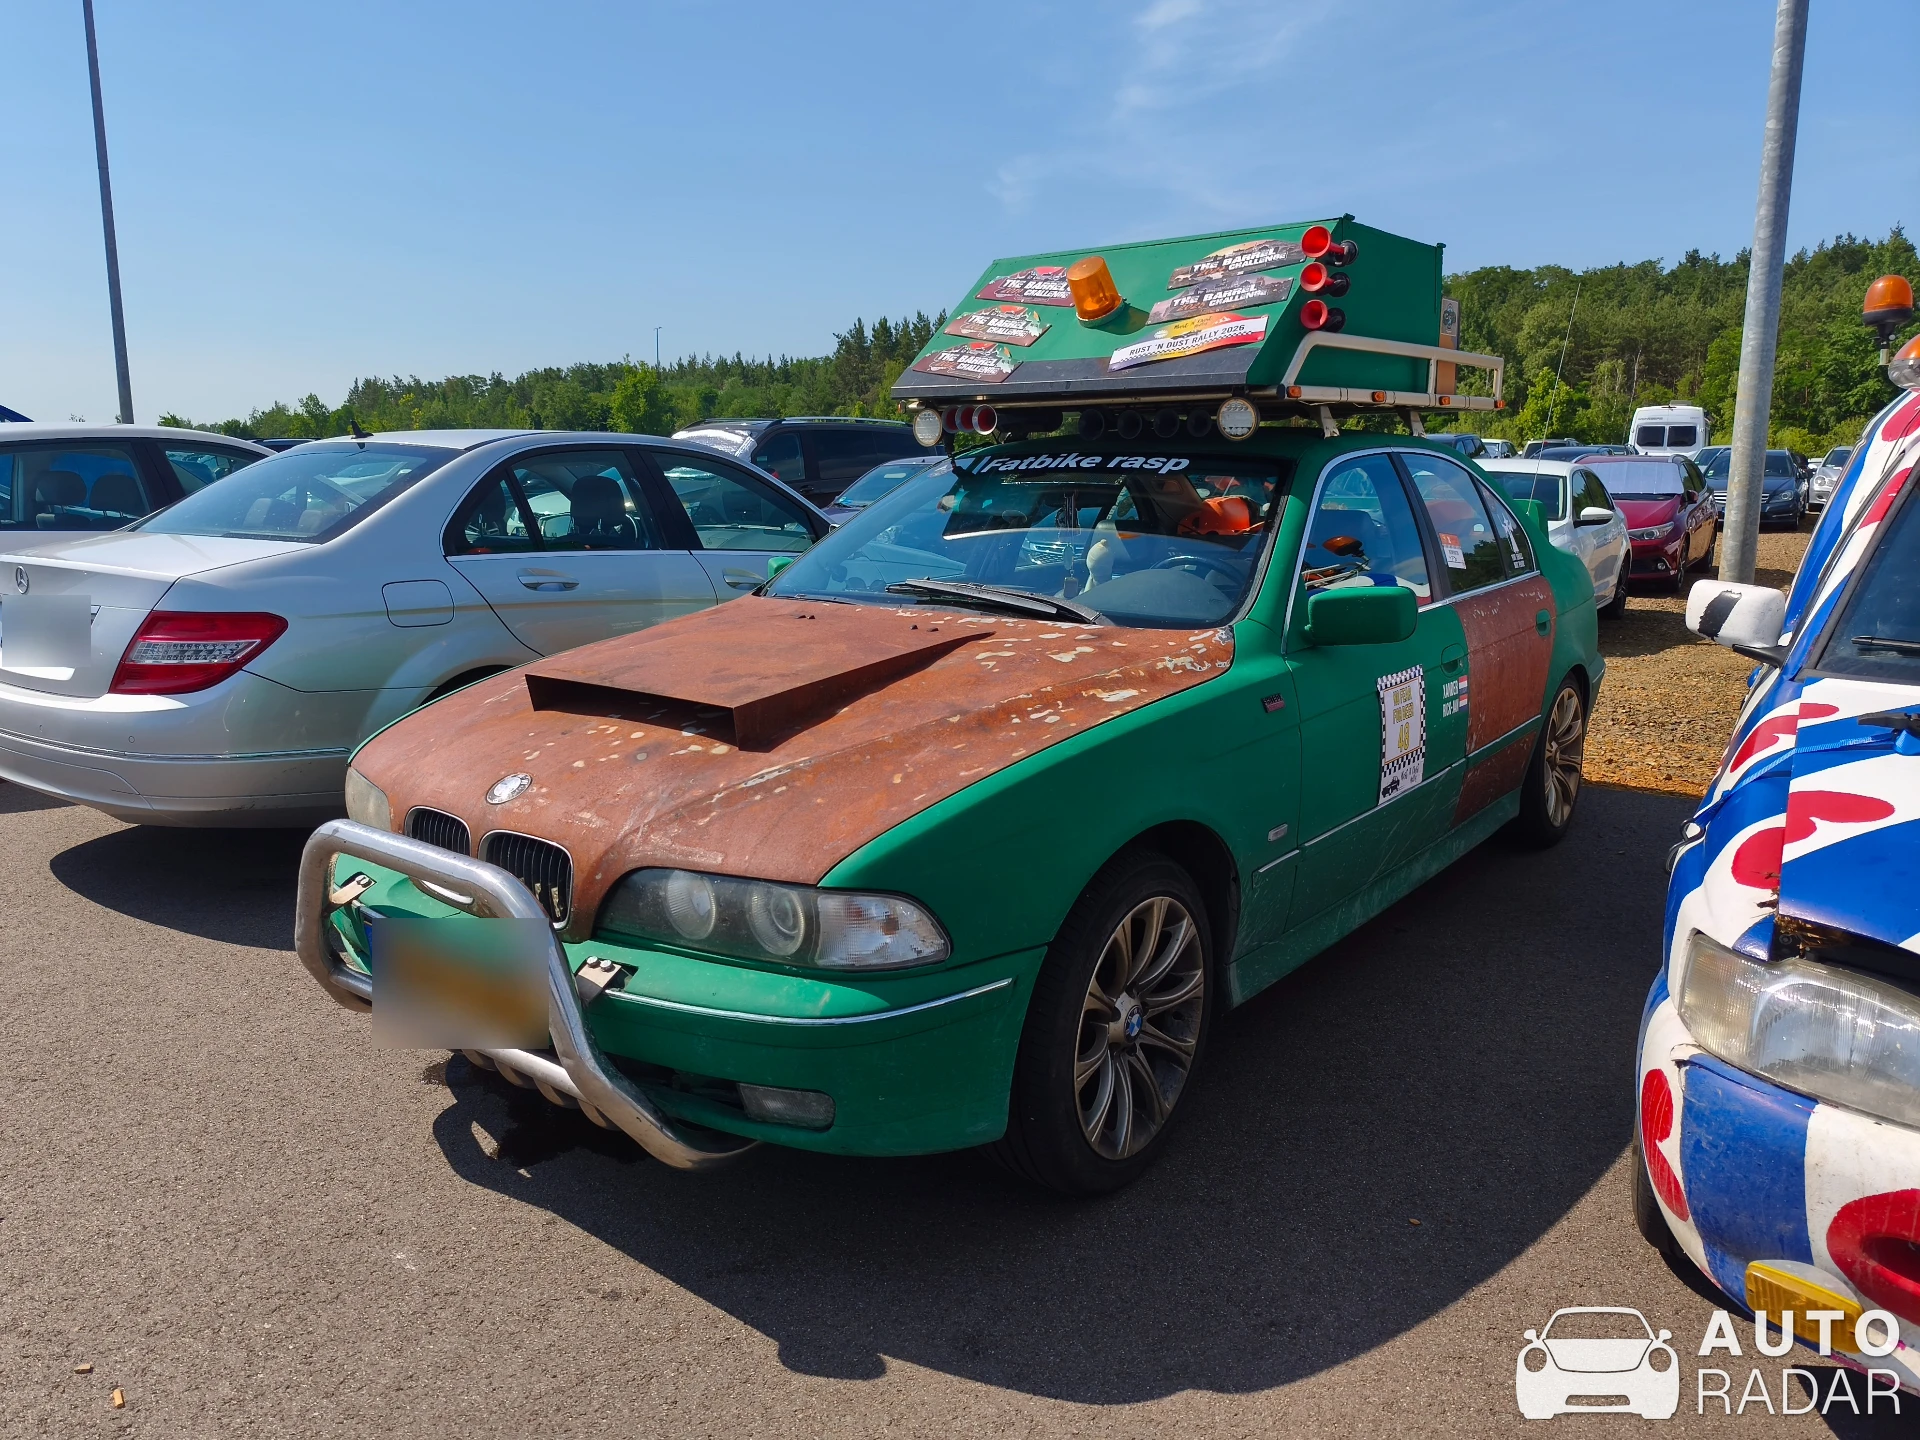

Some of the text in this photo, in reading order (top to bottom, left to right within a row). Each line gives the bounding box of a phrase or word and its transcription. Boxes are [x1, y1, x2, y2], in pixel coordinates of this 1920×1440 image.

[1192, 248, 1276, 272] THE BARREL
[1228, 252, 1287, 271] CHALLENGE
[1004, 279, 1026, 288] THE
[1024, 281, 1068, 291] BARREL
[1173, 283, 1258, 308] THE BARREL
[1208, 289, 1267, 308] CHALLENGE
[967, 315, 989, 323] THE
[987, 318, 1027, 330] BARREL
[1129, 345, 1151, 356] RUST
[1166, 339, 1190, 350] DUST
[1191, 330, 1219, 344] RALLY
[1220, 324, 1246, 335] 2026
[938, 353, 958, 361] THE
[958, 356, 997, 367] BARREL
[981, 452, 1190, 475] Fatbike rasp
